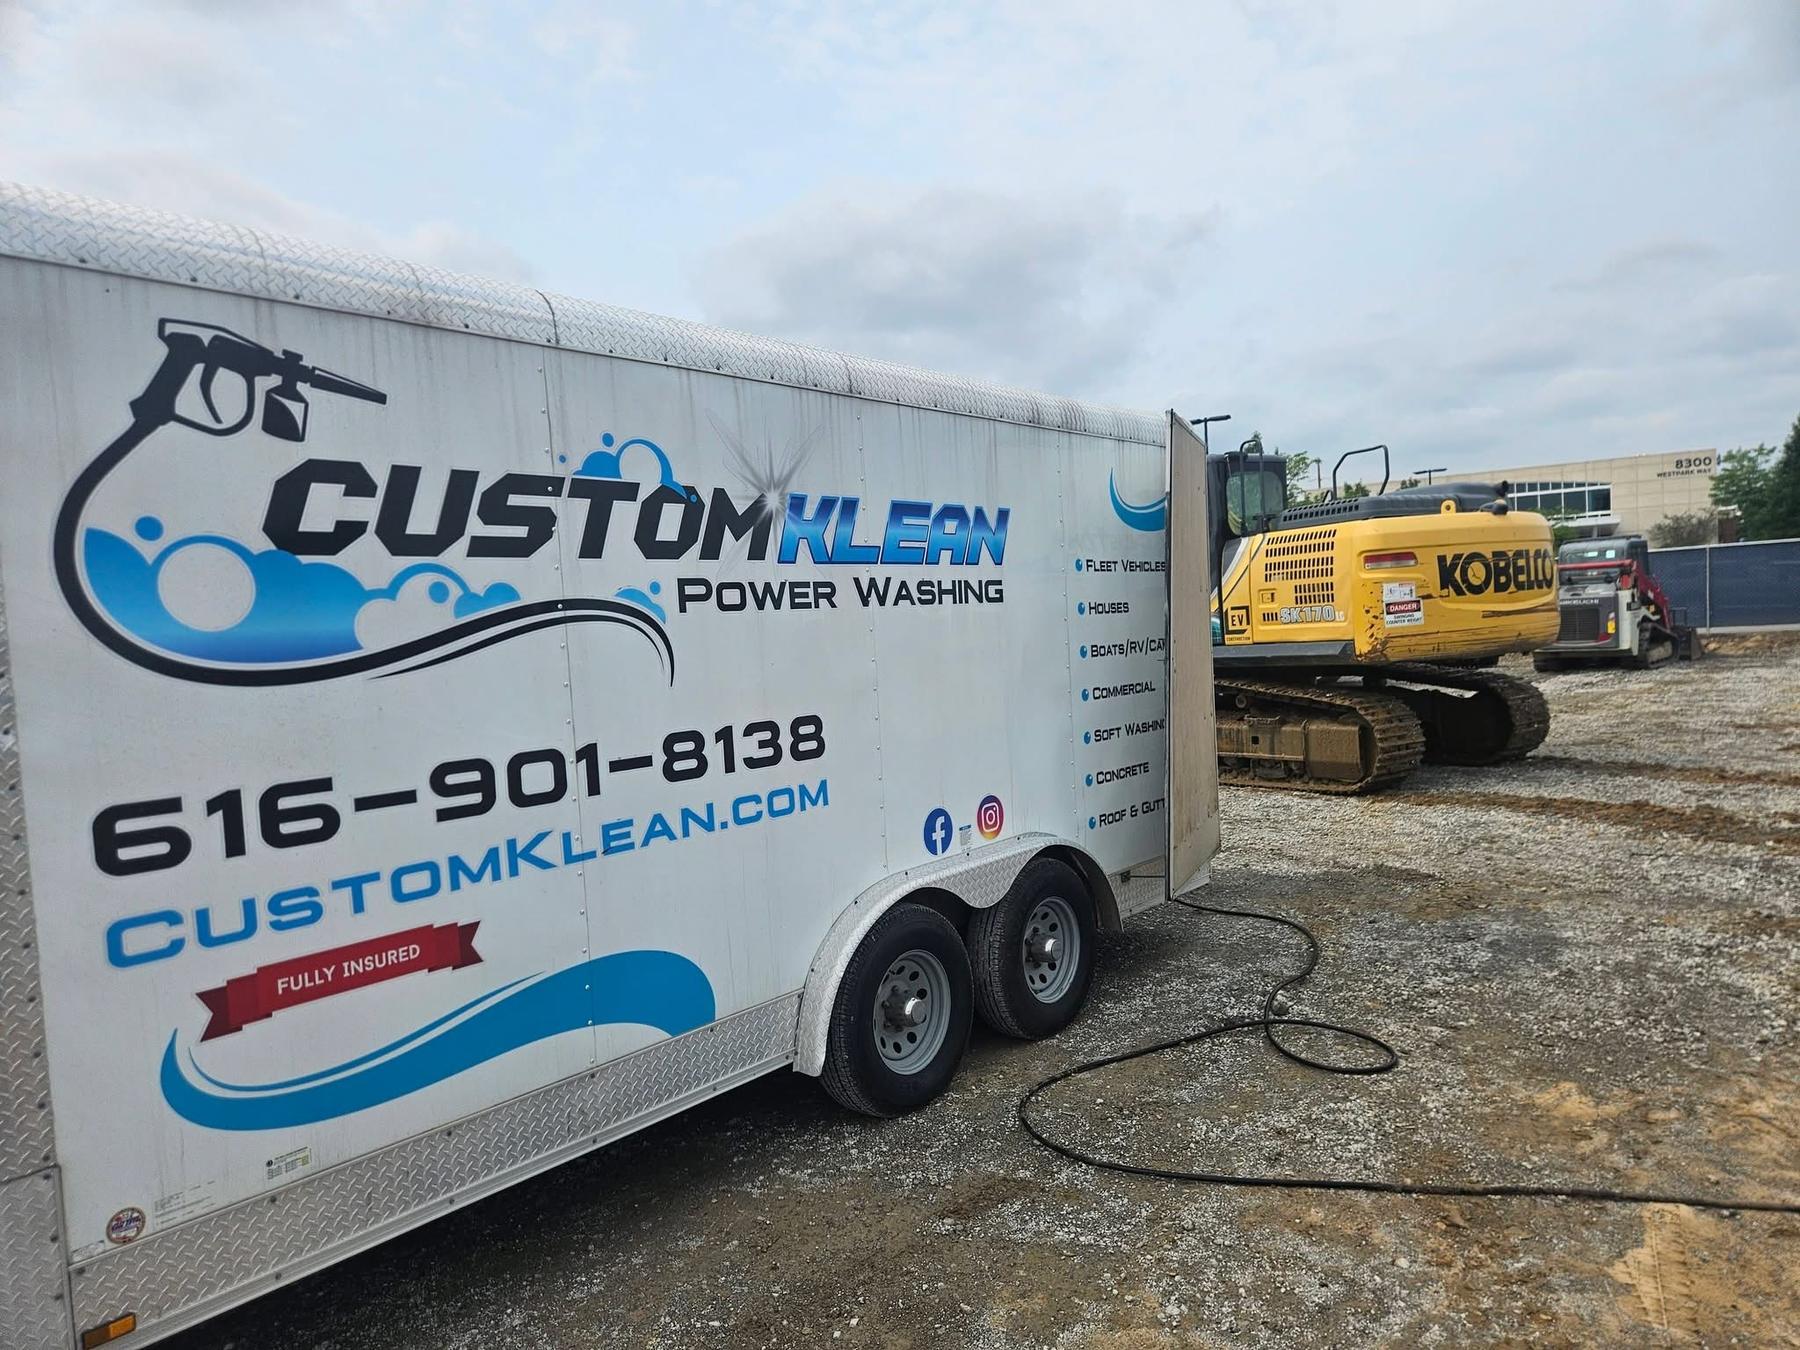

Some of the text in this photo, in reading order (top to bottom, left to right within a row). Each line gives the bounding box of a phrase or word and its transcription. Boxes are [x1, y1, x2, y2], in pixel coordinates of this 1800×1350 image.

[1675, 456, 1712, 469] 8300
[1086, 559, 1166, 572] FLEET VEHICLES
[1437, 548, 1553, 597] KOBELCO
[677, 577, 1004, 613] POWER WASHING
[1088, 602, 1129, 615] HOUSES
[1389, 602, 1417, 612] DANGER
[1231, 614, 1244, 626] EV
[1093, 681, 1156, 700] COMMERCIAL
[1094, 727, 1121, 742] SOFT
[1096, 762, 1149, 784] CONCRETE
[92, 714, 826, 877] 616-901-8138
[1099, 809, 1126, 828] ROOF
[1130, 805, 1138, 818] &
[106, 779, 829, 969] CUSTOMKLEAN.COM
[277, 944, 421, 995] FULLY INSURED
